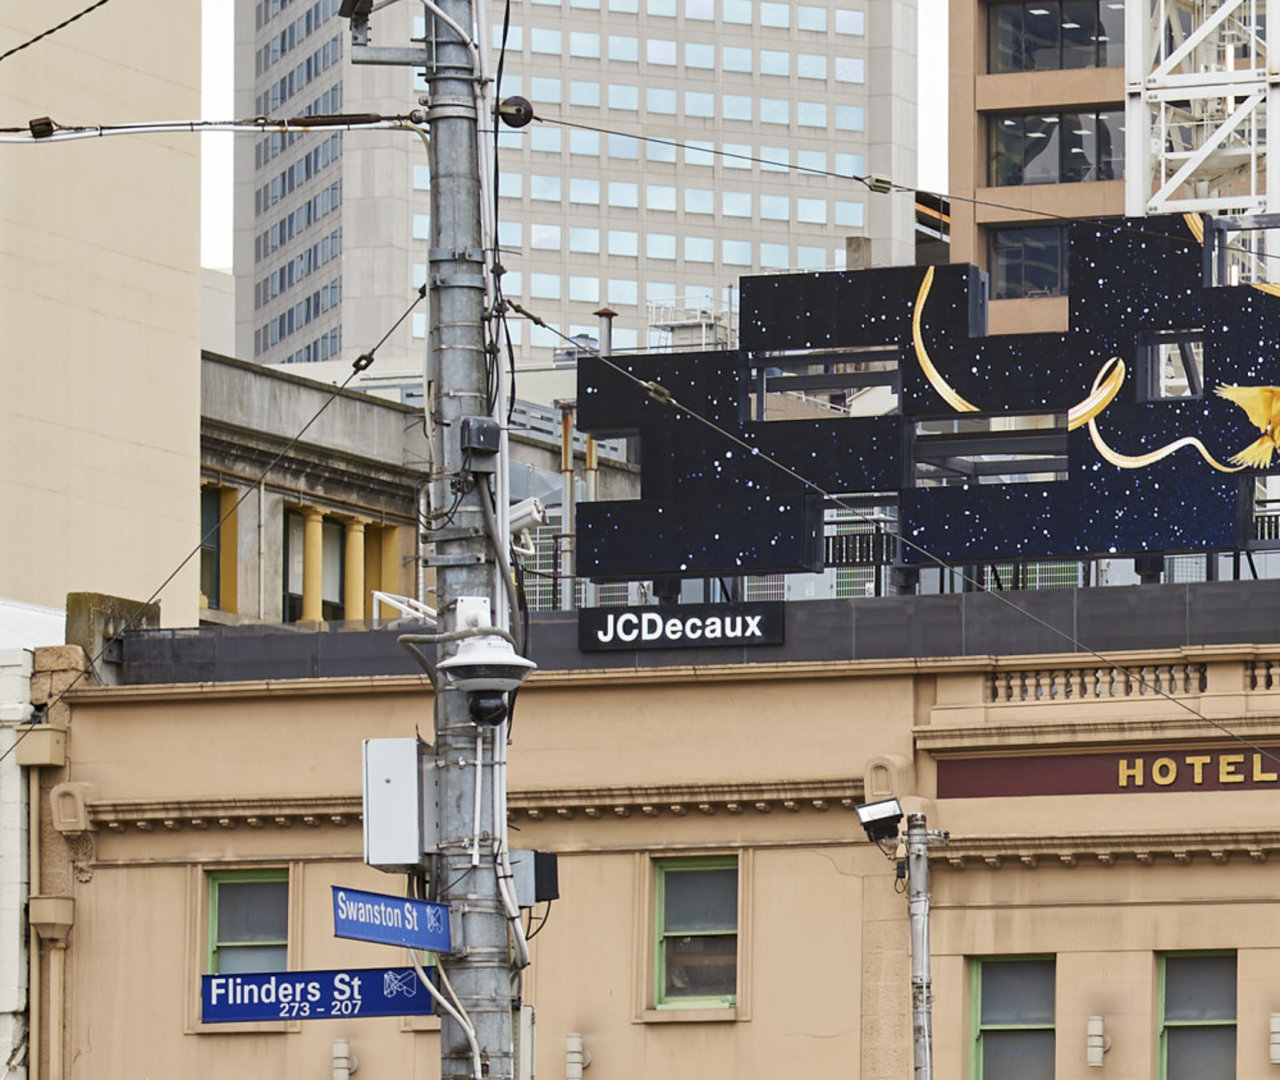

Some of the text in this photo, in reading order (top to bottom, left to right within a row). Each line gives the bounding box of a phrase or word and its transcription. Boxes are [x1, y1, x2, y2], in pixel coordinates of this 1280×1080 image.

[598, 614, 764, 643] JCDecaux
[1117, 752, 1279, 788] HOTEL
[337, 891, 419, 931] Swanston St
[210, 973, 362, 1005] Flinders St
[279, 1002, 311, 1017] 273
[331, 1000, 362, 1015] 207
